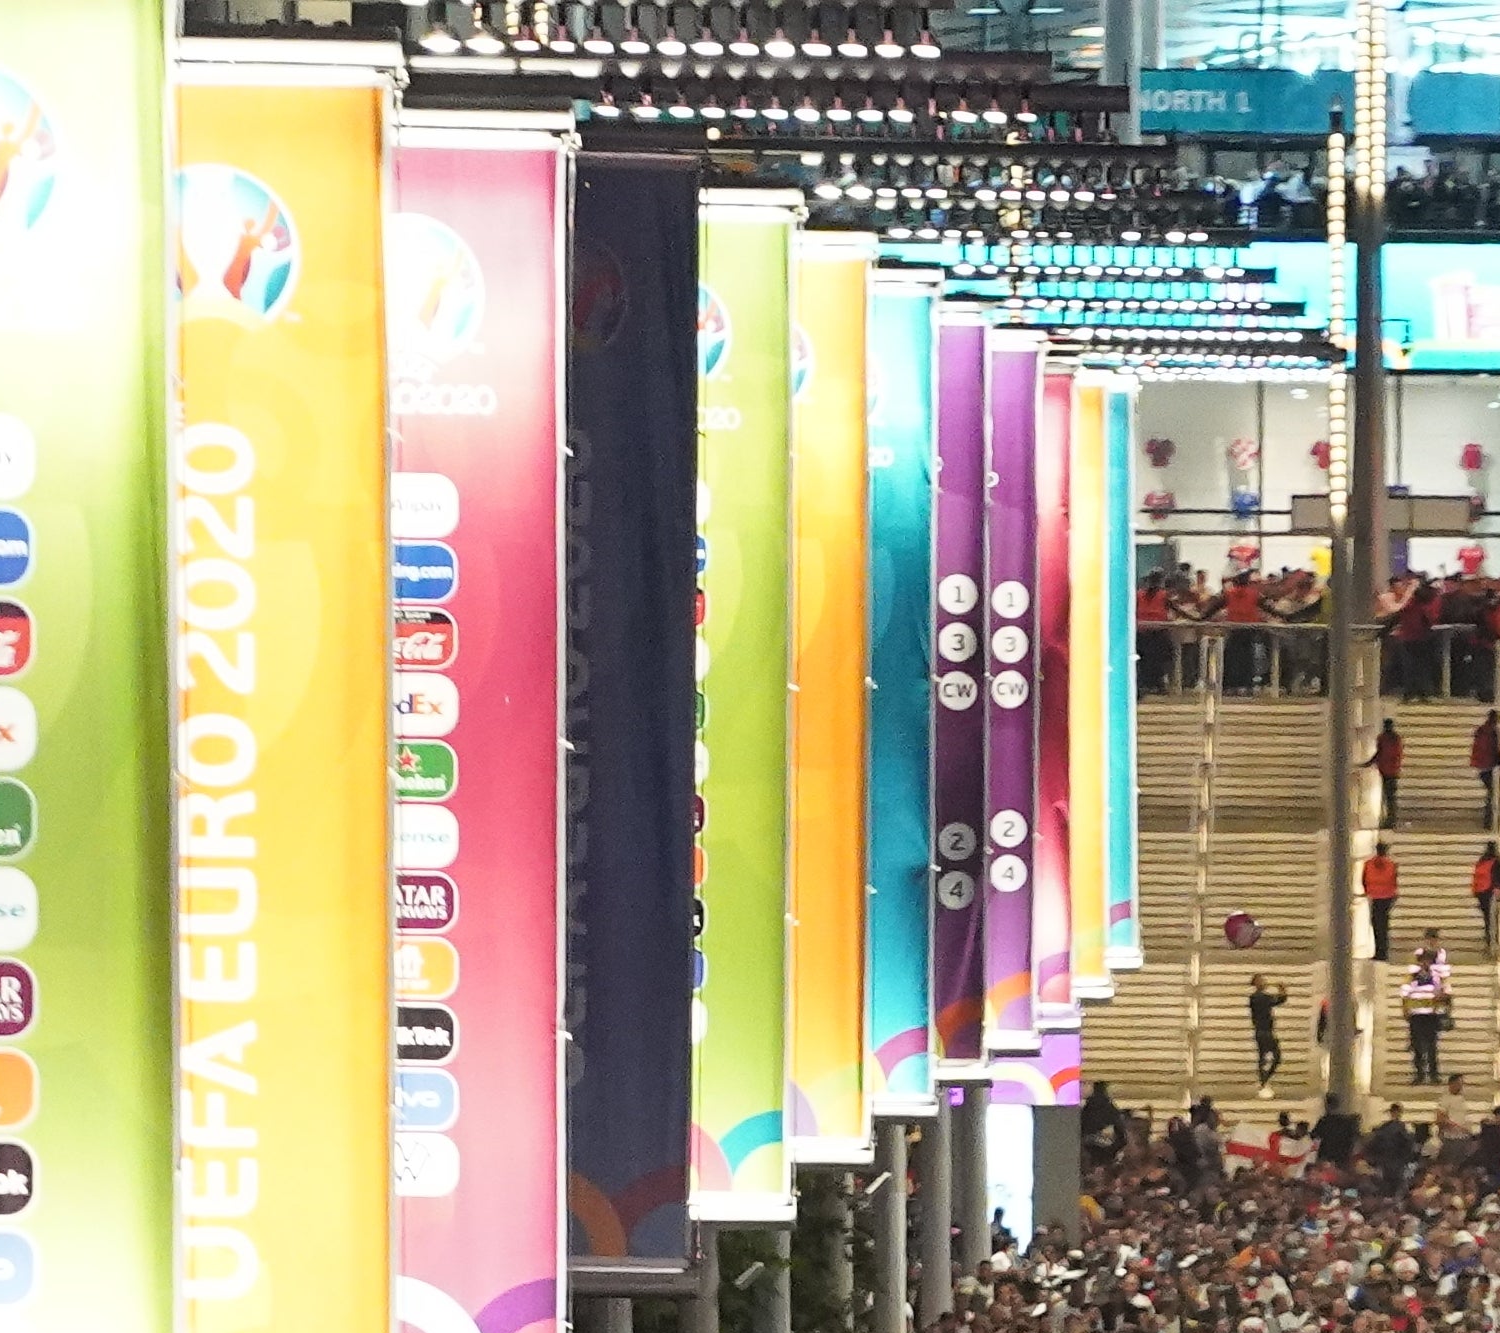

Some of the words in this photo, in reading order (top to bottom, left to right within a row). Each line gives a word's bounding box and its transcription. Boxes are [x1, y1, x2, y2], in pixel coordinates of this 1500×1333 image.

[175, 422, 257, 694] 2020
[953, 585, 966, 604] 1
[951, 633, 966, 651] 3
[1004, 636, 1017, 653] 3
[943, 682, 975, 698] CW
[996, 682, 1025, 696] CW
[1002, 820, 1016, 838] 2
[949, 831, 966, 851] 2
[176, 711, 258, 1002] EURO
[949, 879, 964, 898] 4
[178, 1019, 259, 1300] UEFA
